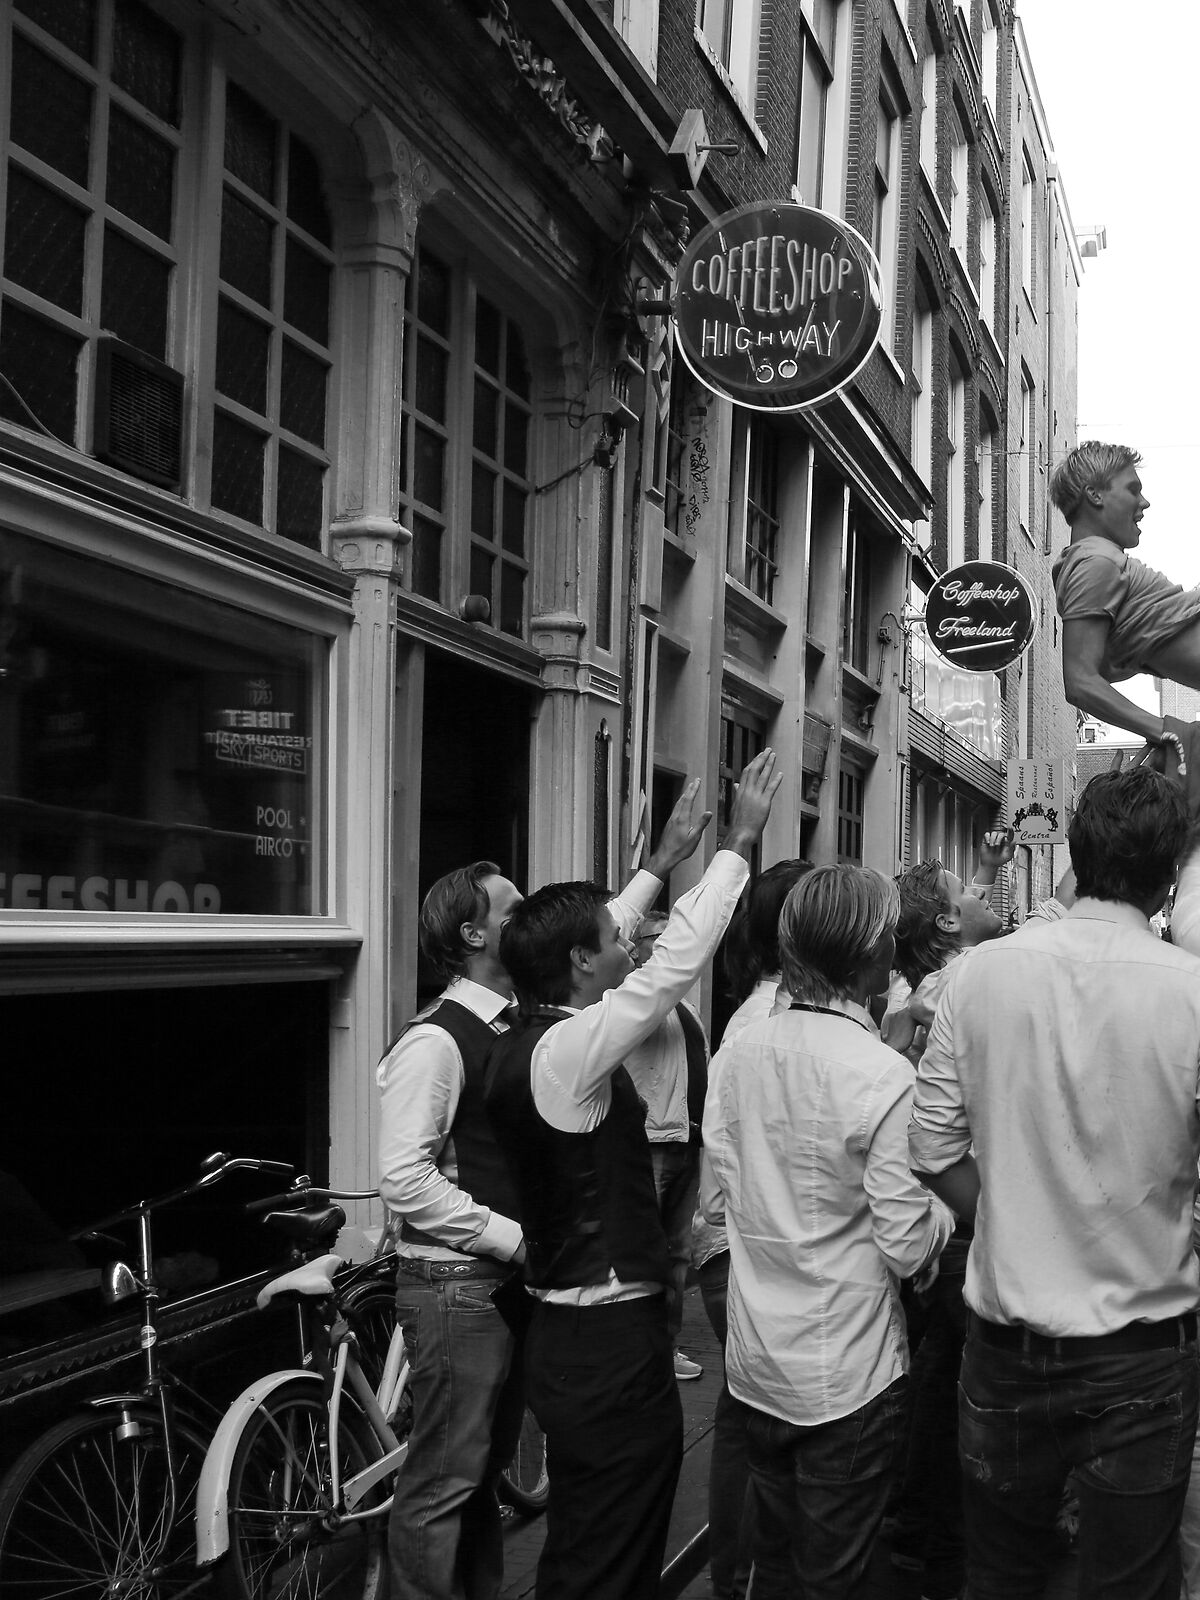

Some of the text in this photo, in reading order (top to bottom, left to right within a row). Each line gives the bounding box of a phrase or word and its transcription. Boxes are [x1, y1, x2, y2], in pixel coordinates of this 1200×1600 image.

[692, 236, 853, 312] COFFEESHOP
[701, 319, 841, 358] HIGHWAY
[940, 580, 1020, 607] Coffeeshop
[935, 616, 1017, 638] Freeland
[221, 742, 302, 768] SKY SPORTS
[1015, 766, 1026, 799] Spaans
[1044, 763, 1055, 800] Español
[256, 805, 293, 830] POOL
[255, 835, 293, 858] AIRCO
[1020, 830, 1050, 841] Centra
